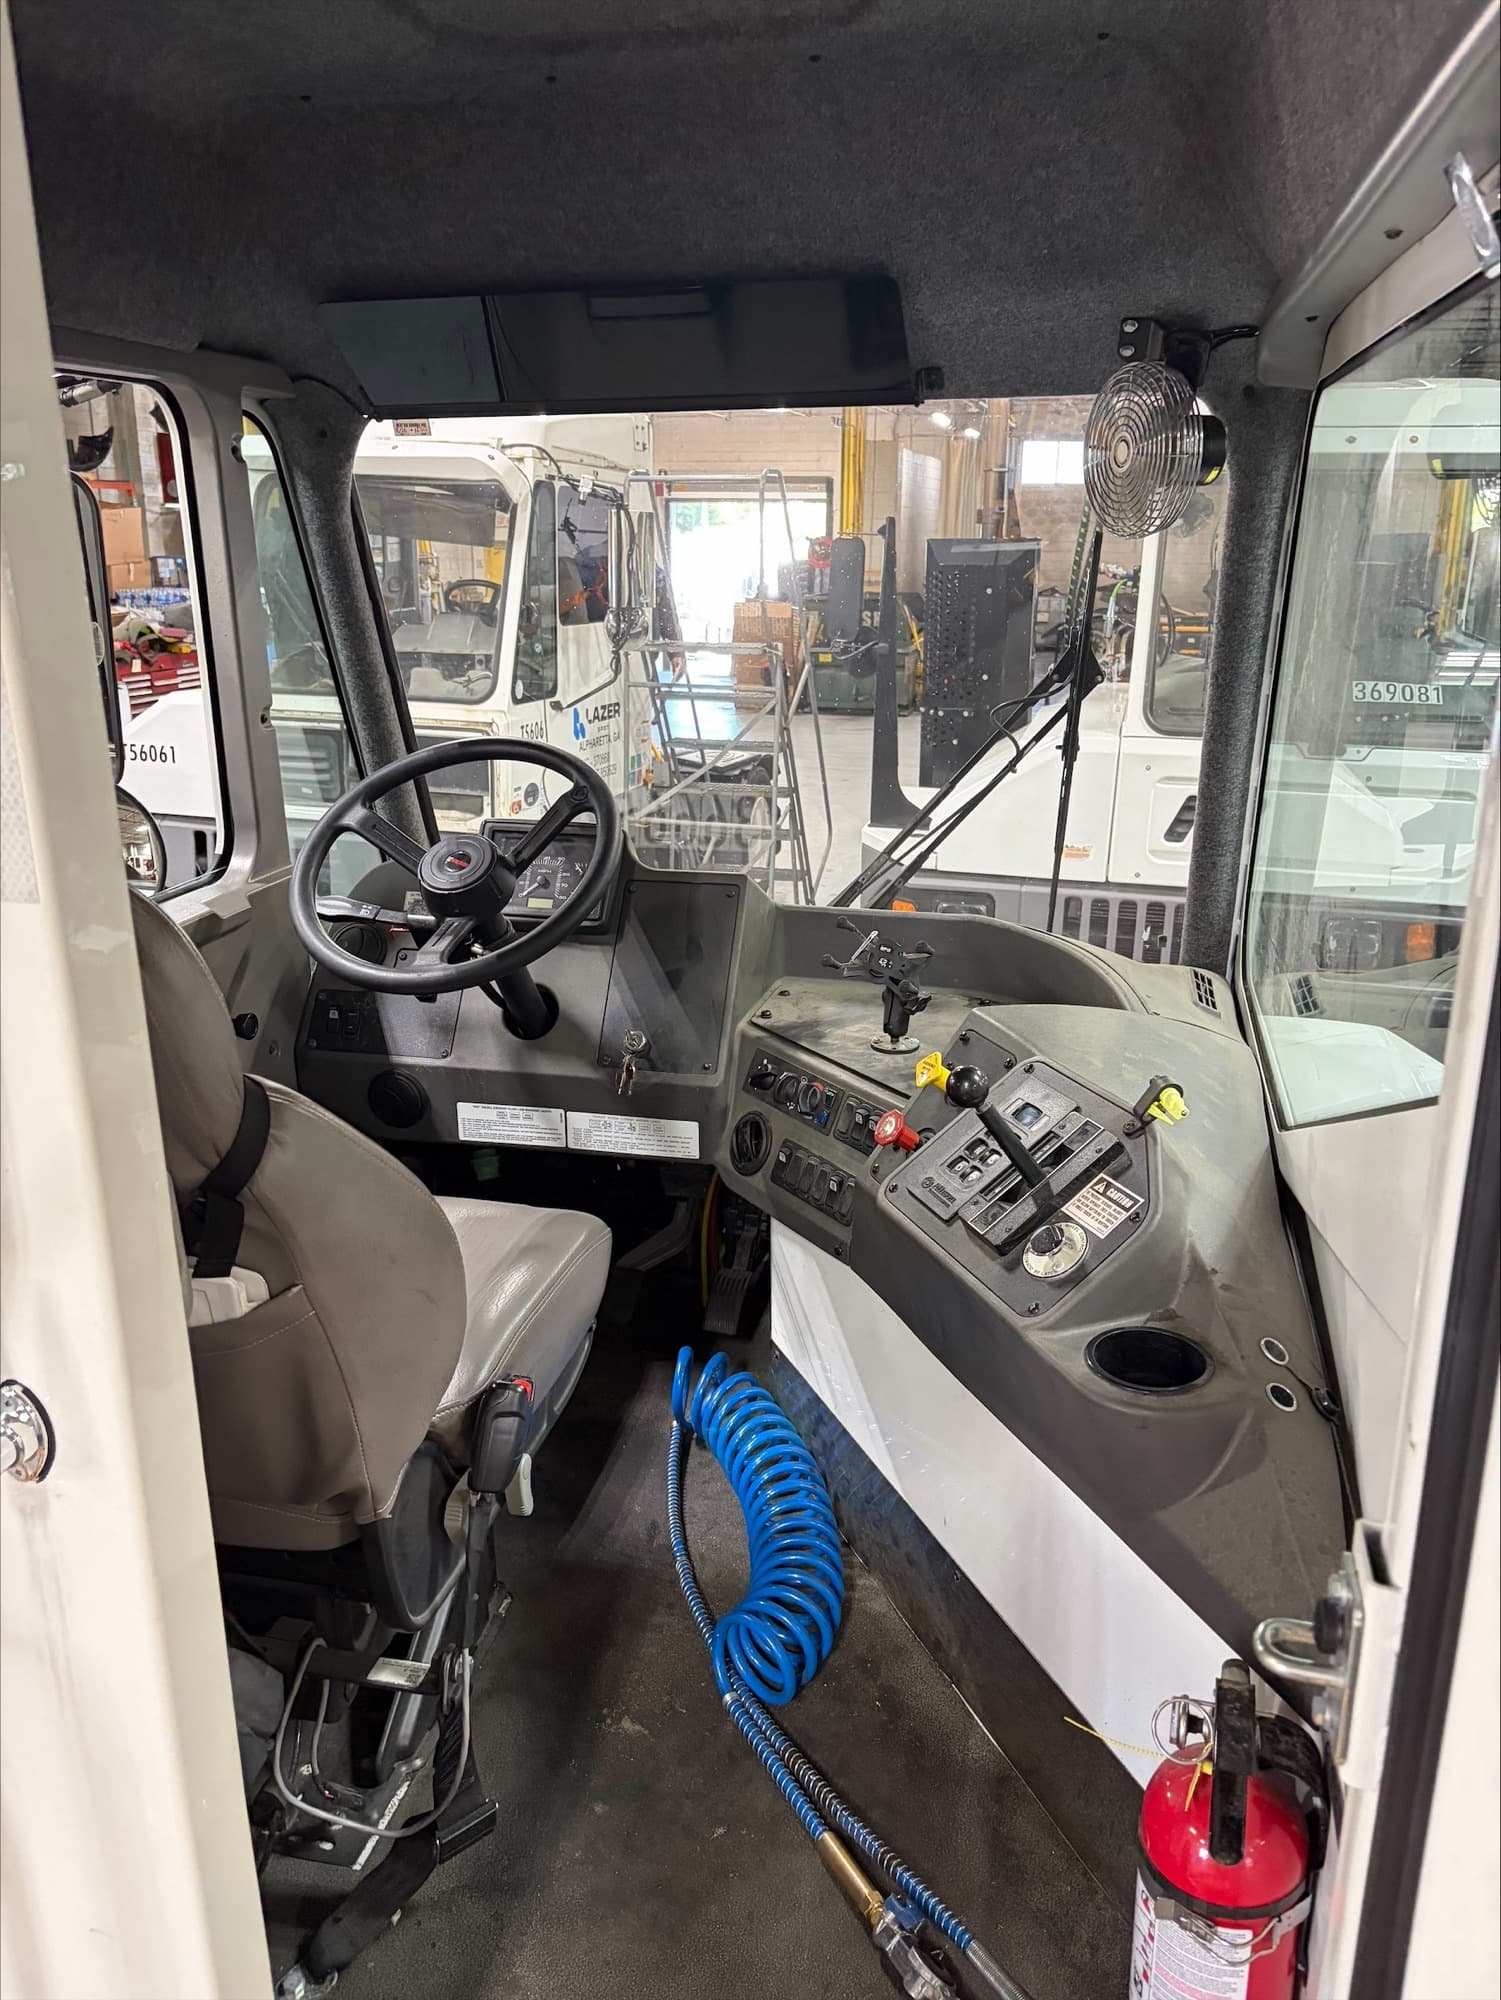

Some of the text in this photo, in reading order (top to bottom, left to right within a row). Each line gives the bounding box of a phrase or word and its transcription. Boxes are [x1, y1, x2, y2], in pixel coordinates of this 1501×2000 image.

[1354, 681, 1442, 704] 369081
[585, 701, 621, 724] LAZER
[1105, 1187, 1135, 1209] CAUTION
